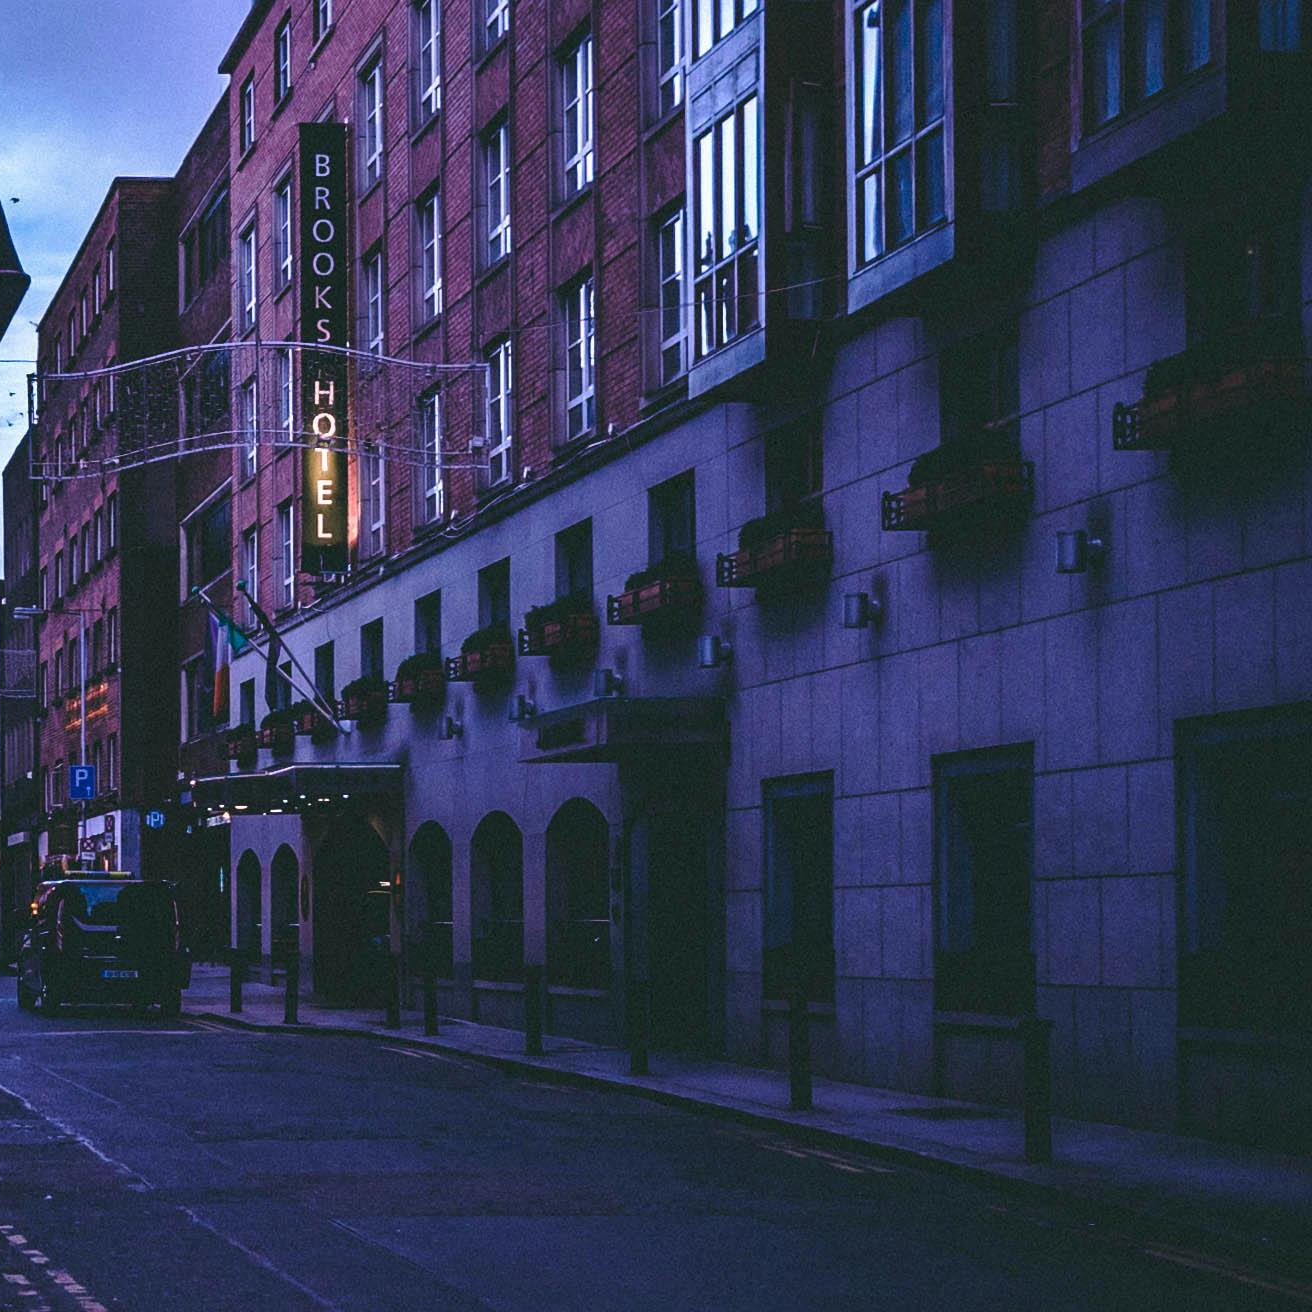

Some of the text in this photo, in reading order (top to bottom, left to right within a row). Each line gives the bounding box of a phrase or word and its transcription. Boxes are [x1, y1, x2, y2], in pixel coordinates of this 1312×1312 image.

[311, 153, 337, 539] BROOKS HOTEL
[75, 768, 88, 788] P
